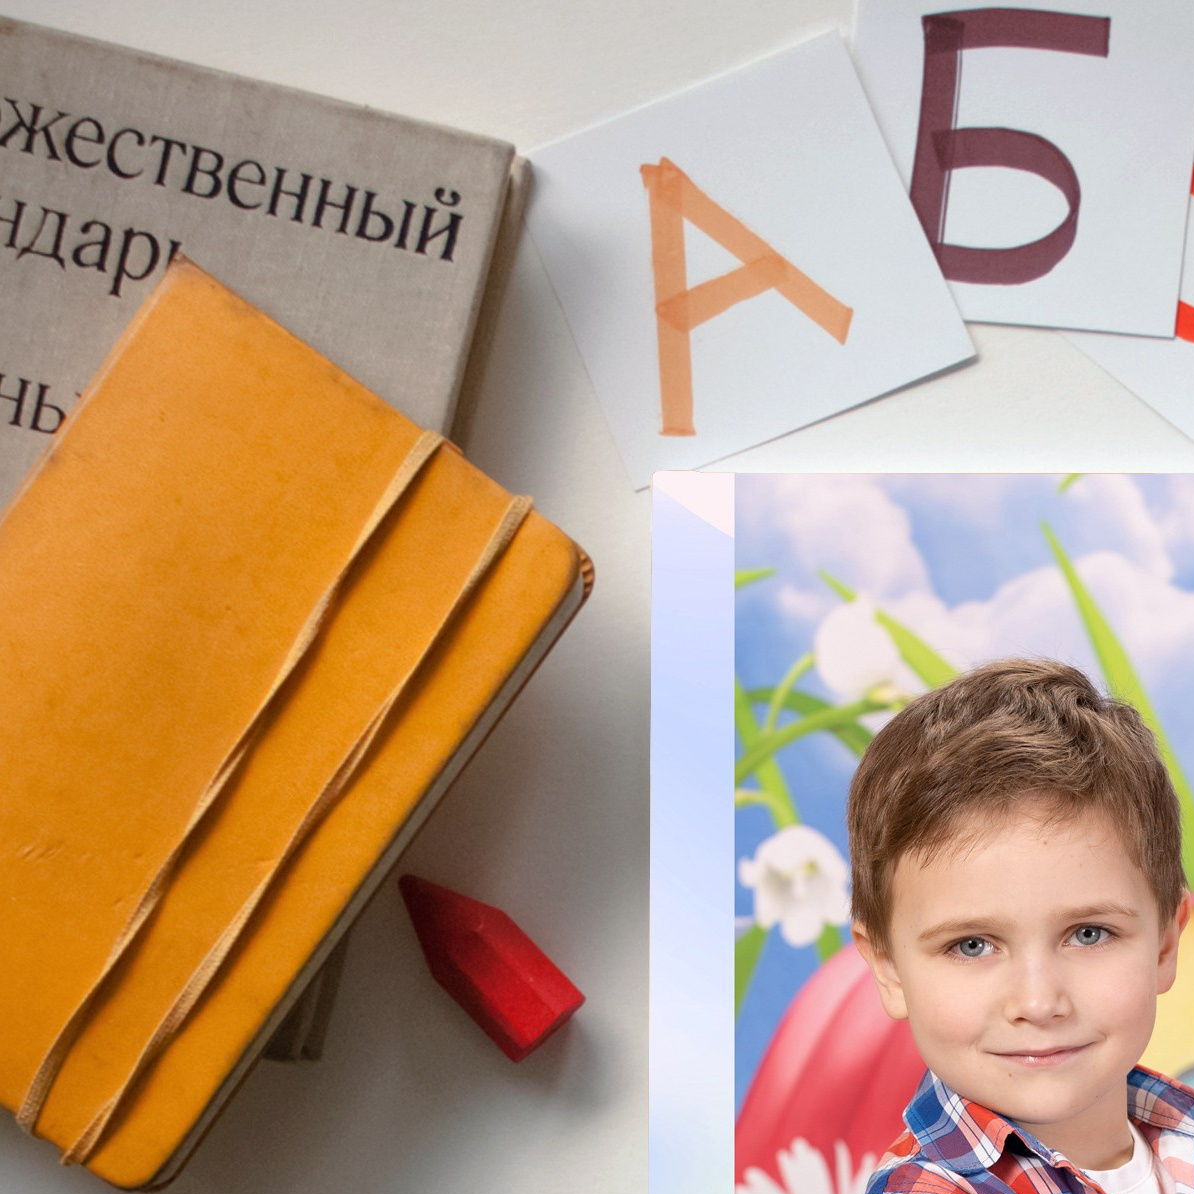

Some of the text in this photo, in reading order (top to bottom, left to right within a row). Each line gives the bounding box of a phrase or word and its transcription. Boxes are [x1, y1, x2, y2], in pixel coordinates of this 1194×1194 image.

[0, 97, 464, 262] жественный
[0, 196, 181, 297] ндар
[911, 8, 1110, 286] Б
[640, 157, 853, 436] А
